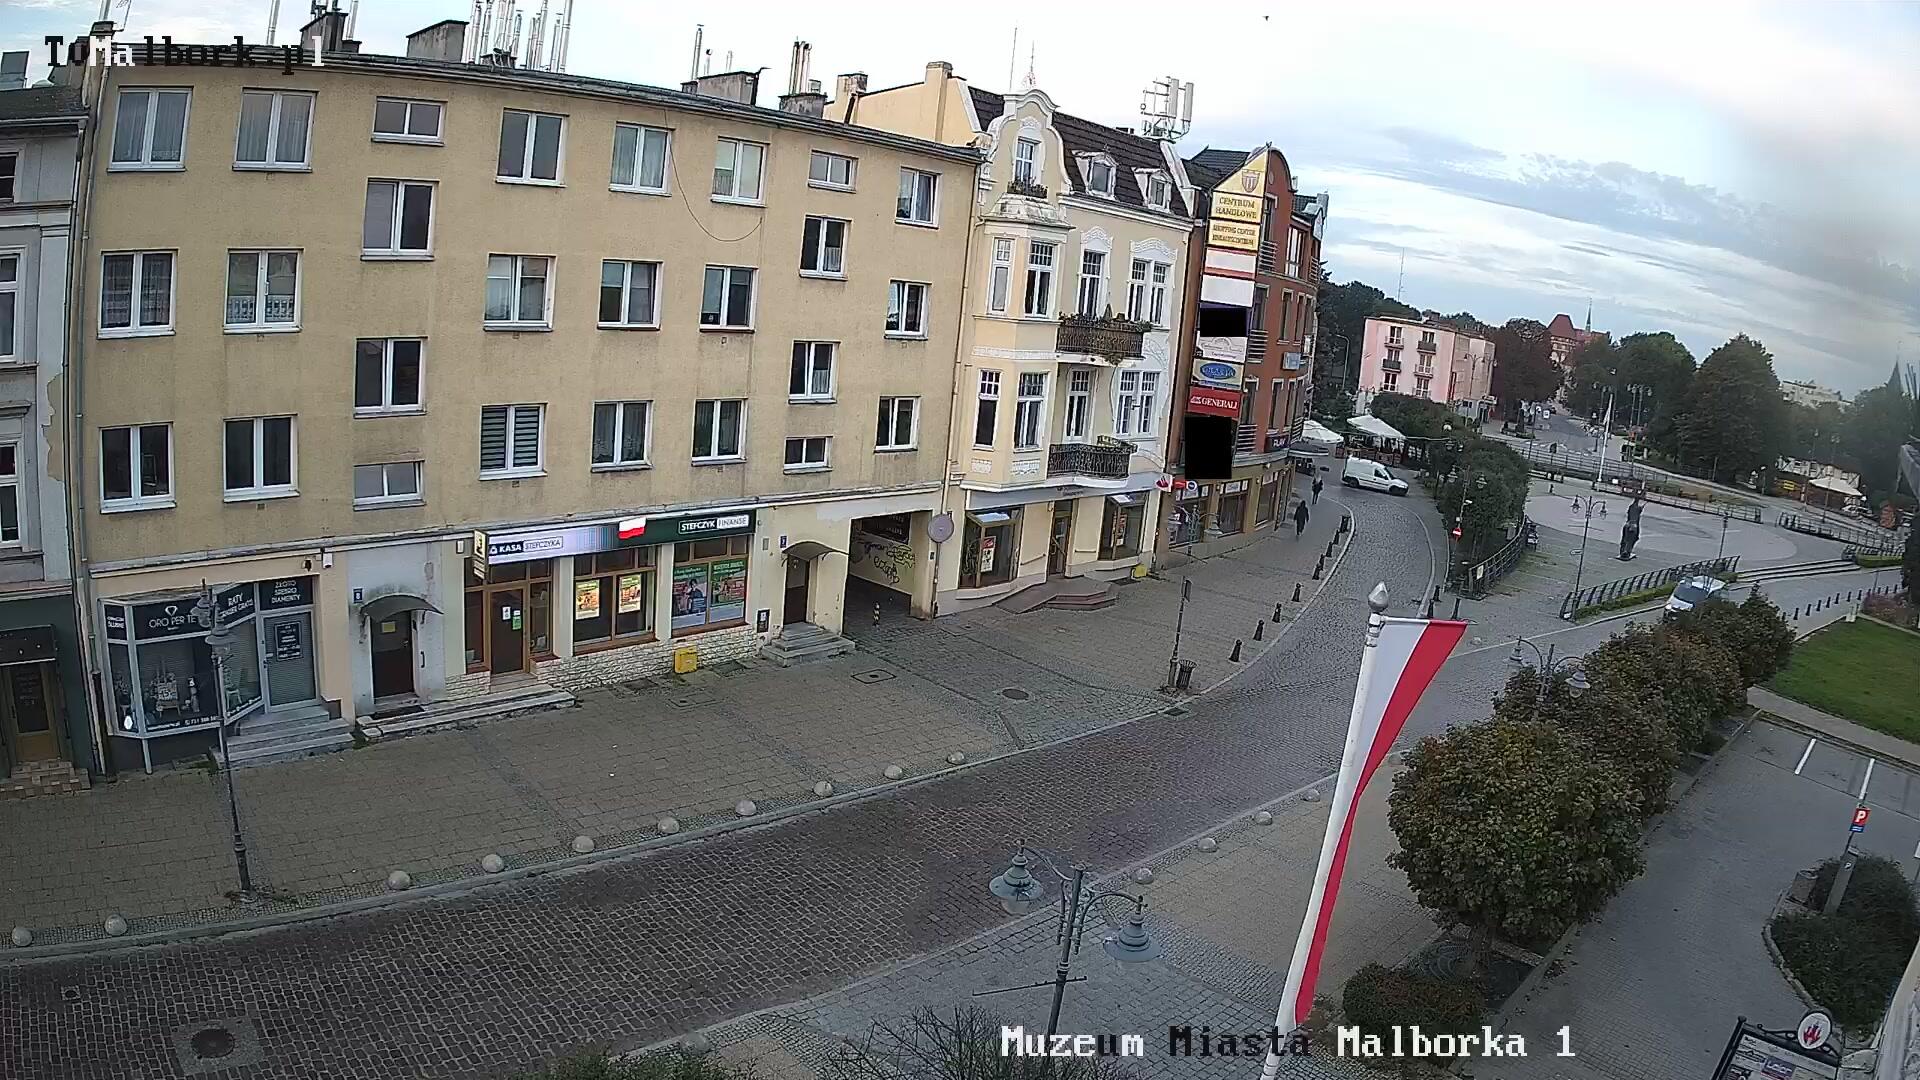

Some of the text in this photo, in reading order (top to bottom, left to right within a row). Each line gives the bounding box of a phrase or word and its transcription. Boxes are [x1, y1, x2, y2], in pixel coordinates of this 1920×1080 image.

[1219, 196, 1256, 208] CENTRUM
[1215, 207, 1257, 219] HANDLOWE
[1201, 397, 1238, 409] GENERALI
[680, 516, 748, 531] STEFCZYK FINANSE
[499, 539, 561, 553] KASA STEFCZYKA
[148, 617, 170, 629] ORO
[170, 615, 185, 625] PER
[187, 613, 198, 624] TE
[1854, 810, 1867, 823] P
